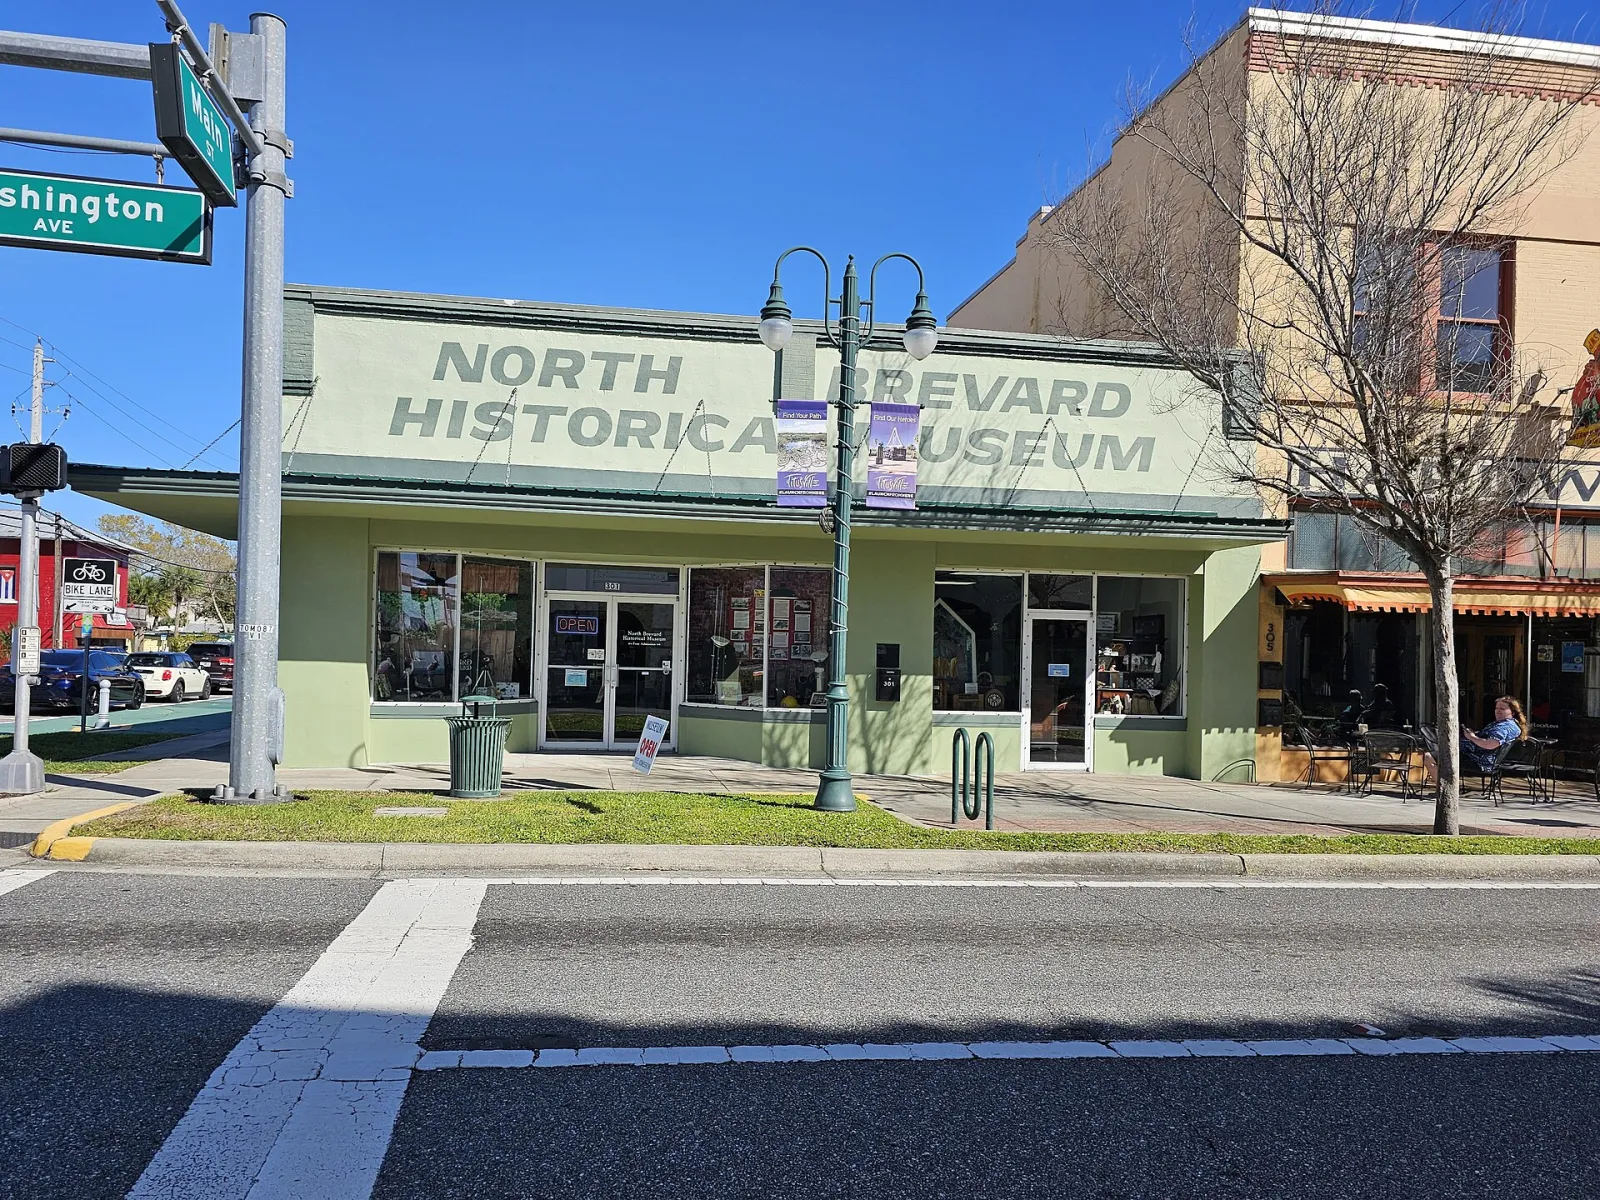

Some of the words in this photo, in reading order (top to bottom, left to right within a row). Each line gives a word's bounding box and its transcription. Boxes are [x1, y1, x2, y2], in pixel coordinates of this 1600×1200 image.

[190, 81, 223, 153] Main
[205, 139, 215, 161] ST
[0, 184, 164, 223] shington
[33, 217, 74, 235] AVE
[433, 341, 683, 395] NORTH
[826, 366, 1132, 419] BREVARD
[388, 397, 778, 454] HISTORICA
[853, 422, 1155, 473] USEUM
[65, 585, 85, 594] BIKE
[89, 585, 112, 596] LANE
[605, 582, 620, 590] 301
[559, 618, 595, 632] OPEN
[1265, 623, 1275, 651] 305
[640, 737, 658, 759] OPEN
